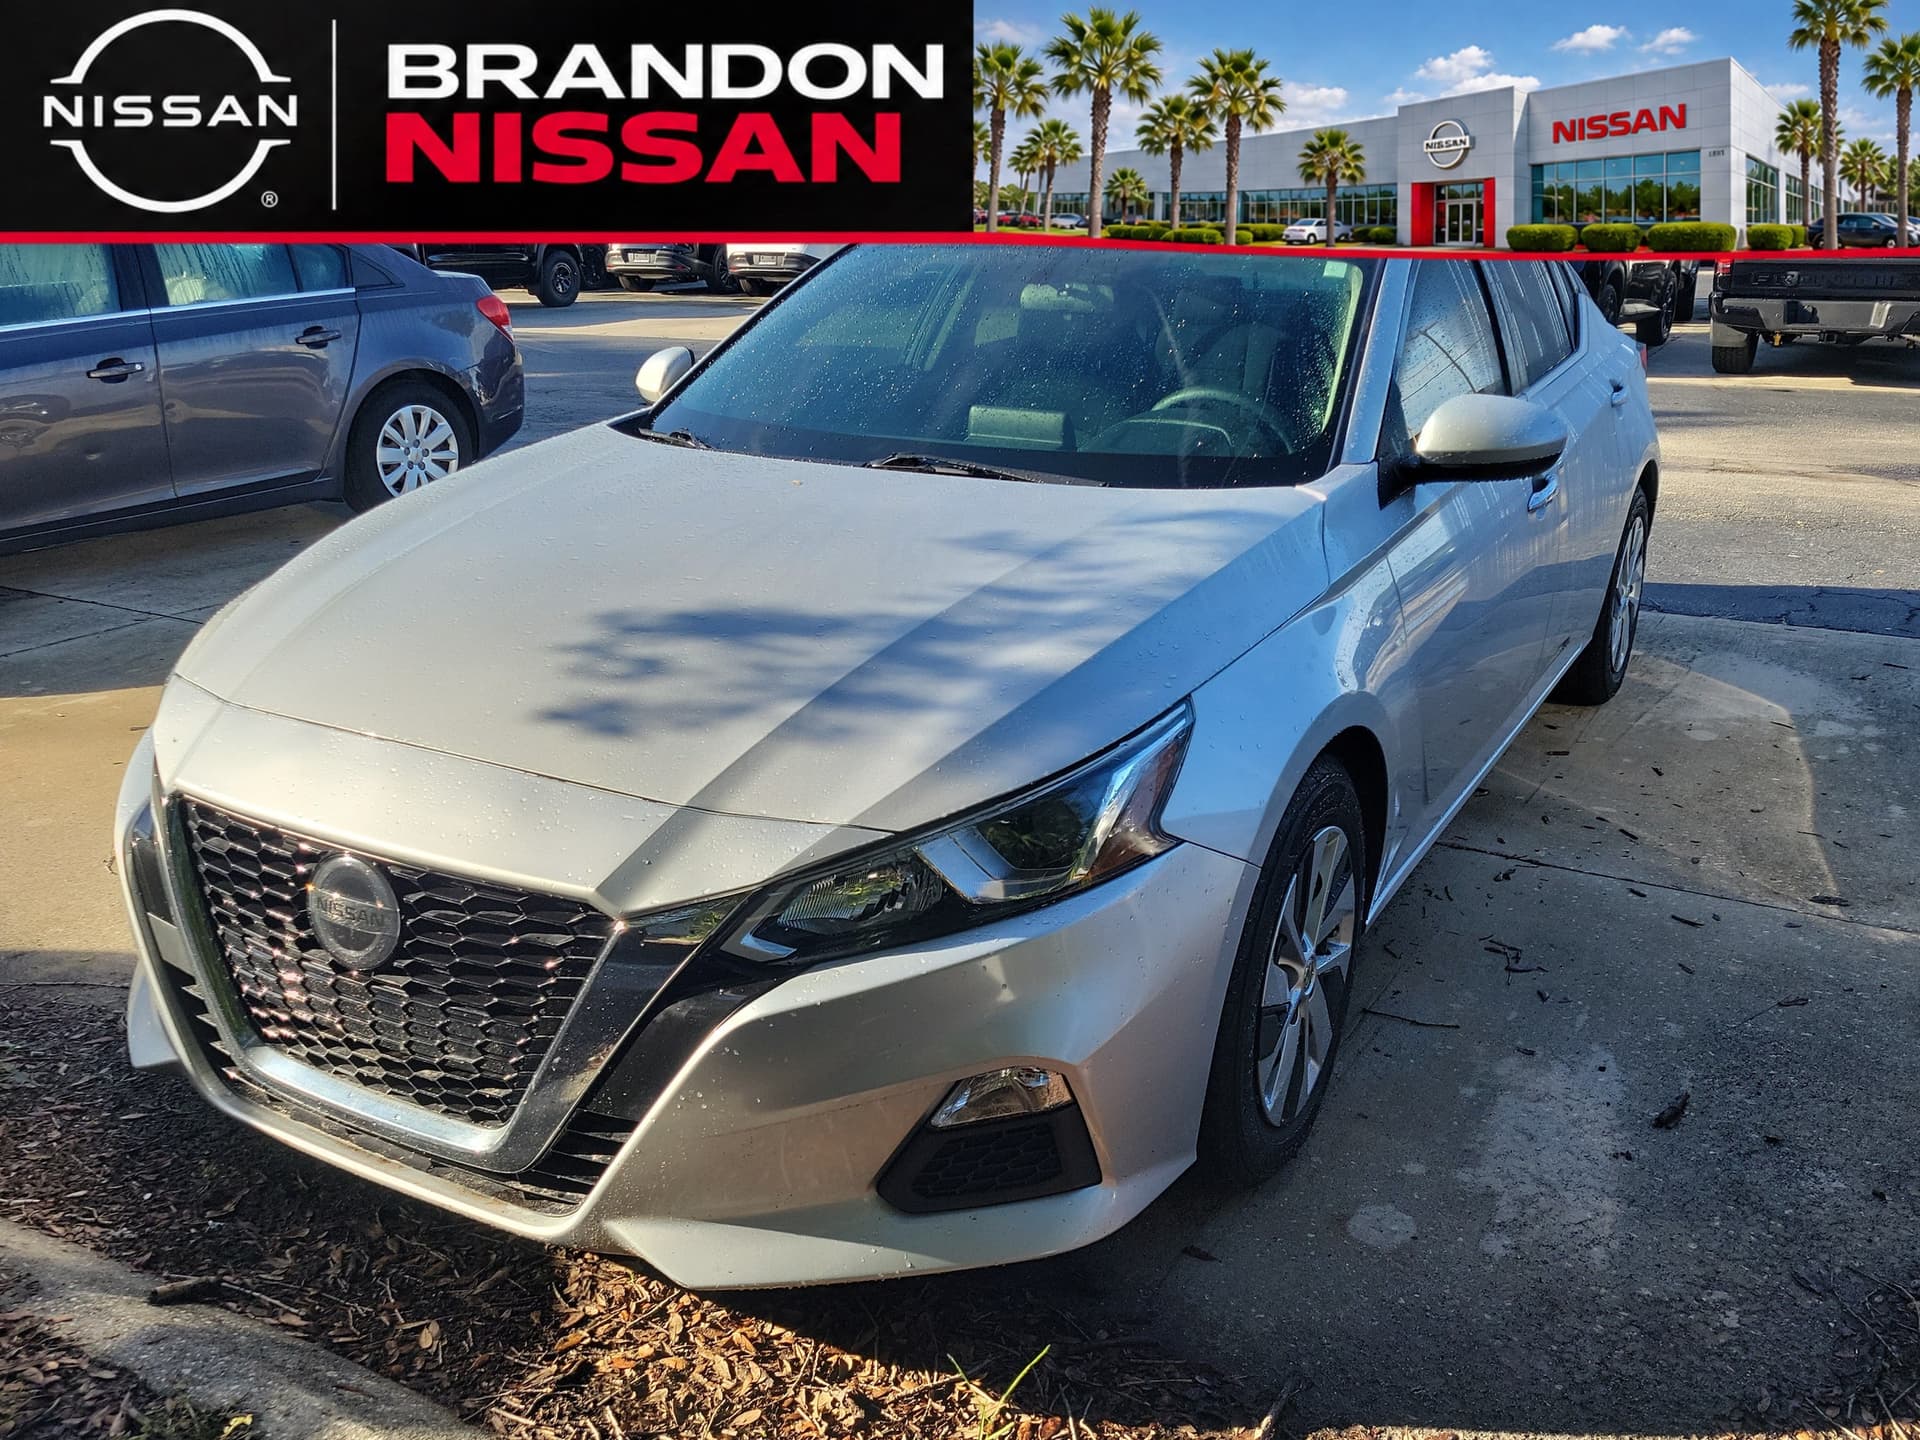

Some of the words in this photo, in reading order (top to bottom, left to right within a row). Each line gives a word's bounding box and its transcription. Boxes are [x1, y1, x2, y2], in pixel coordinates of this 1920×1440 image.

[1553, 103, 1687, 144] NISSAN
[1426, 139, 1466, 150] NISSAN
[315, 897, 385, 928] NISSAN
